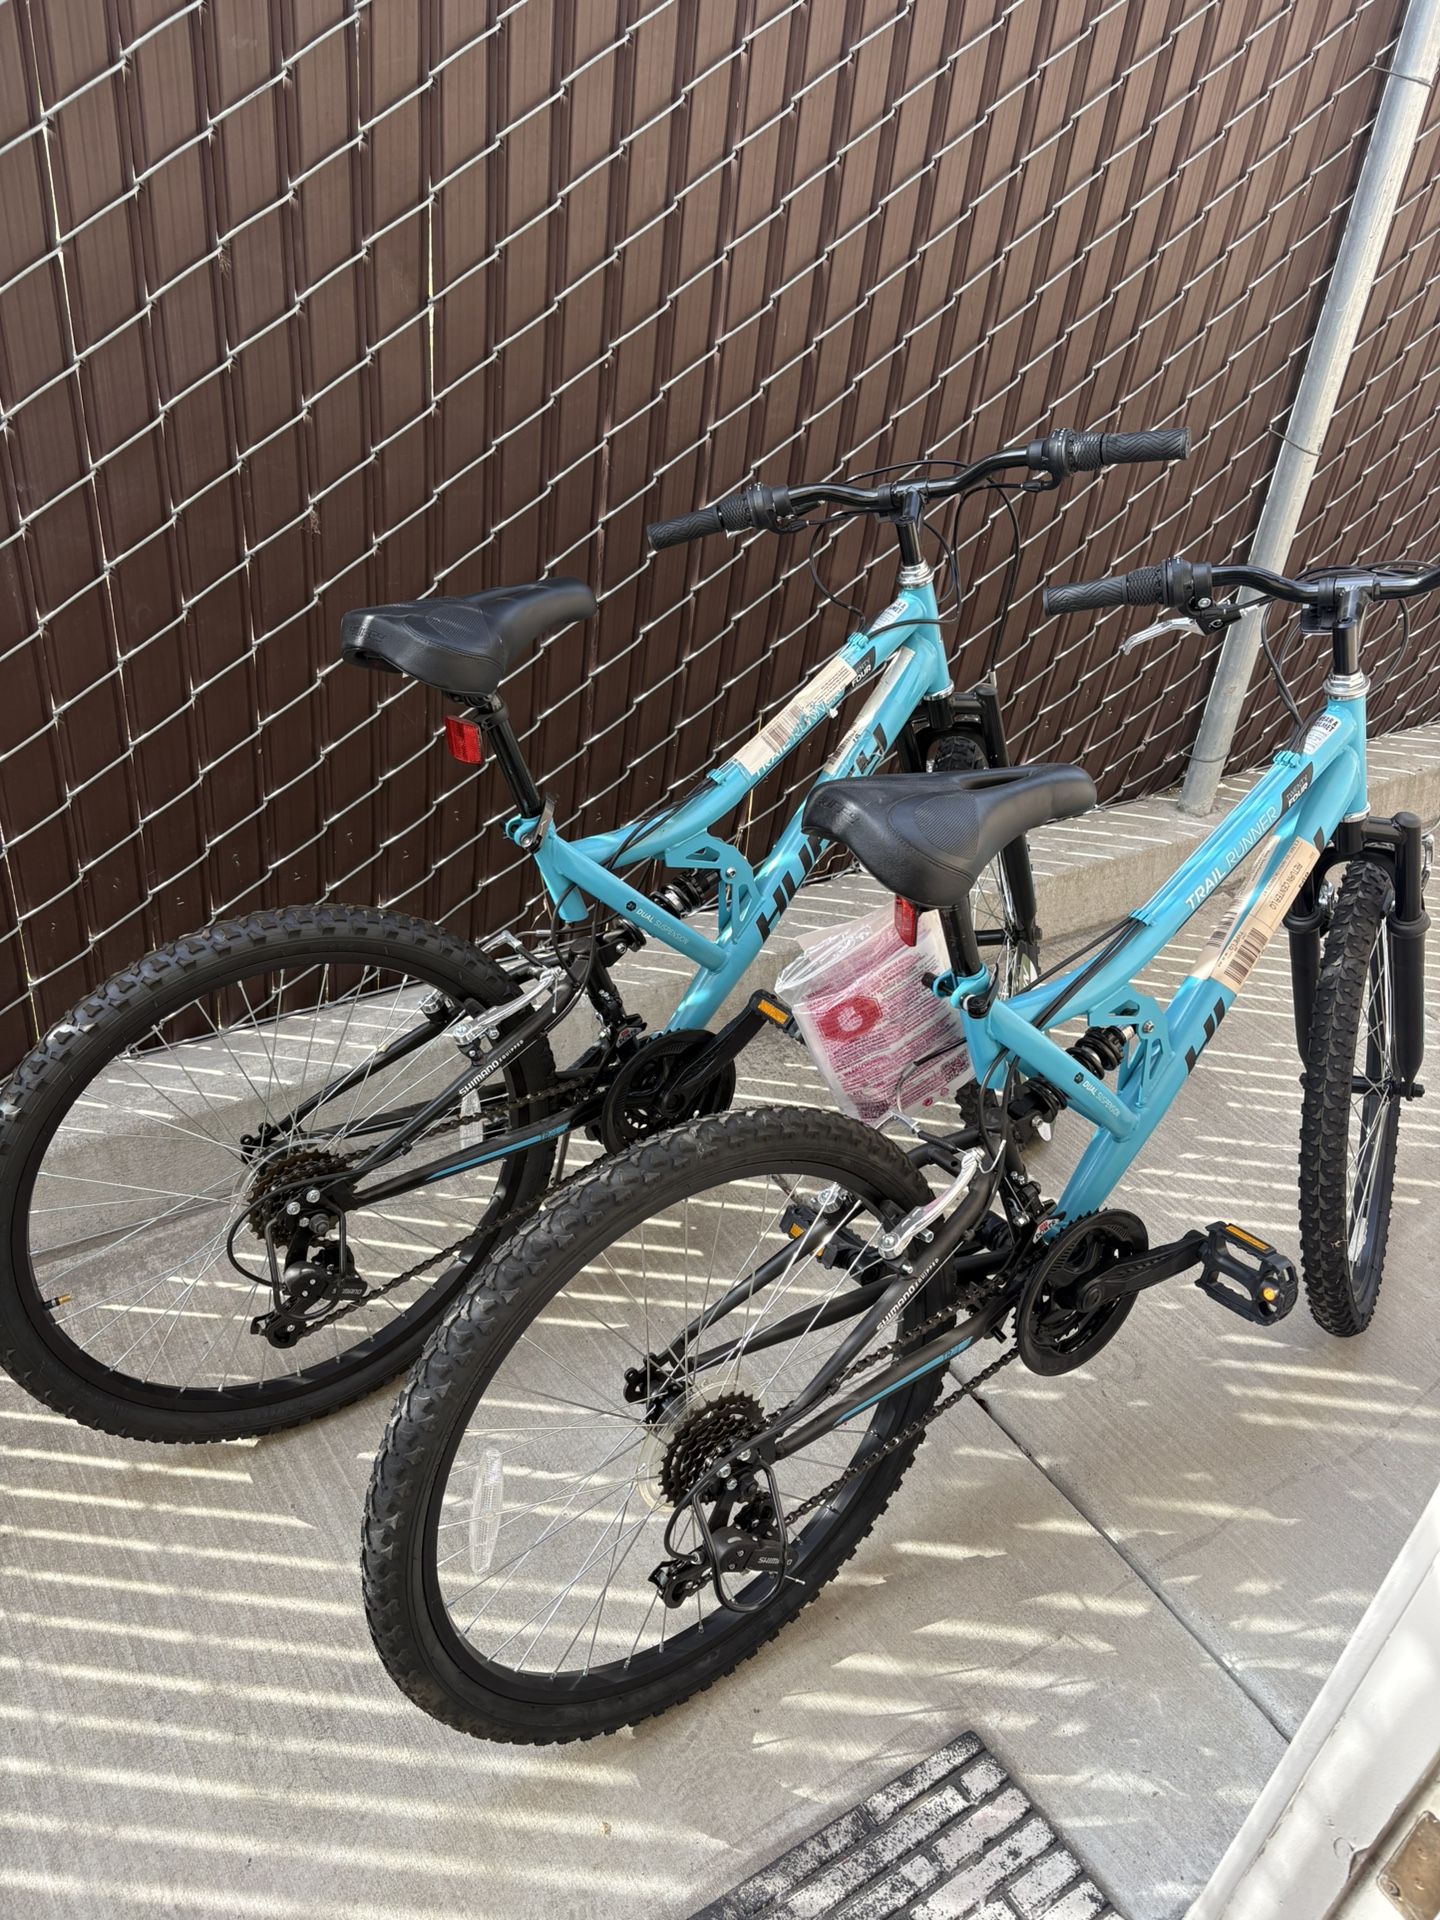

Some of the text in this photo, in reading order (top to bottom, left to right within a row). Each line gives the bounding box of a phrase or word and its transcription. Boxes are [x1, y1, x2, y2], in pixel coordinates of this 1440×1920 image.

[851, 664, 872, 687] FOUR
[1288, 782, 1309, 805] FOUR
[1185, 866, 1226, 911] TRAIL
[1226, 805, 1278, 869] RUNNER
[635, 908, 654, 924] DUAL
[653, 916, 690, 945] SUSPENSION
[458, 1059, 500, 1097] SHIMANO
[1082, 1080, 1099, 1097] DUAL
[876, 1284, 914, 1332] SHIMANO
